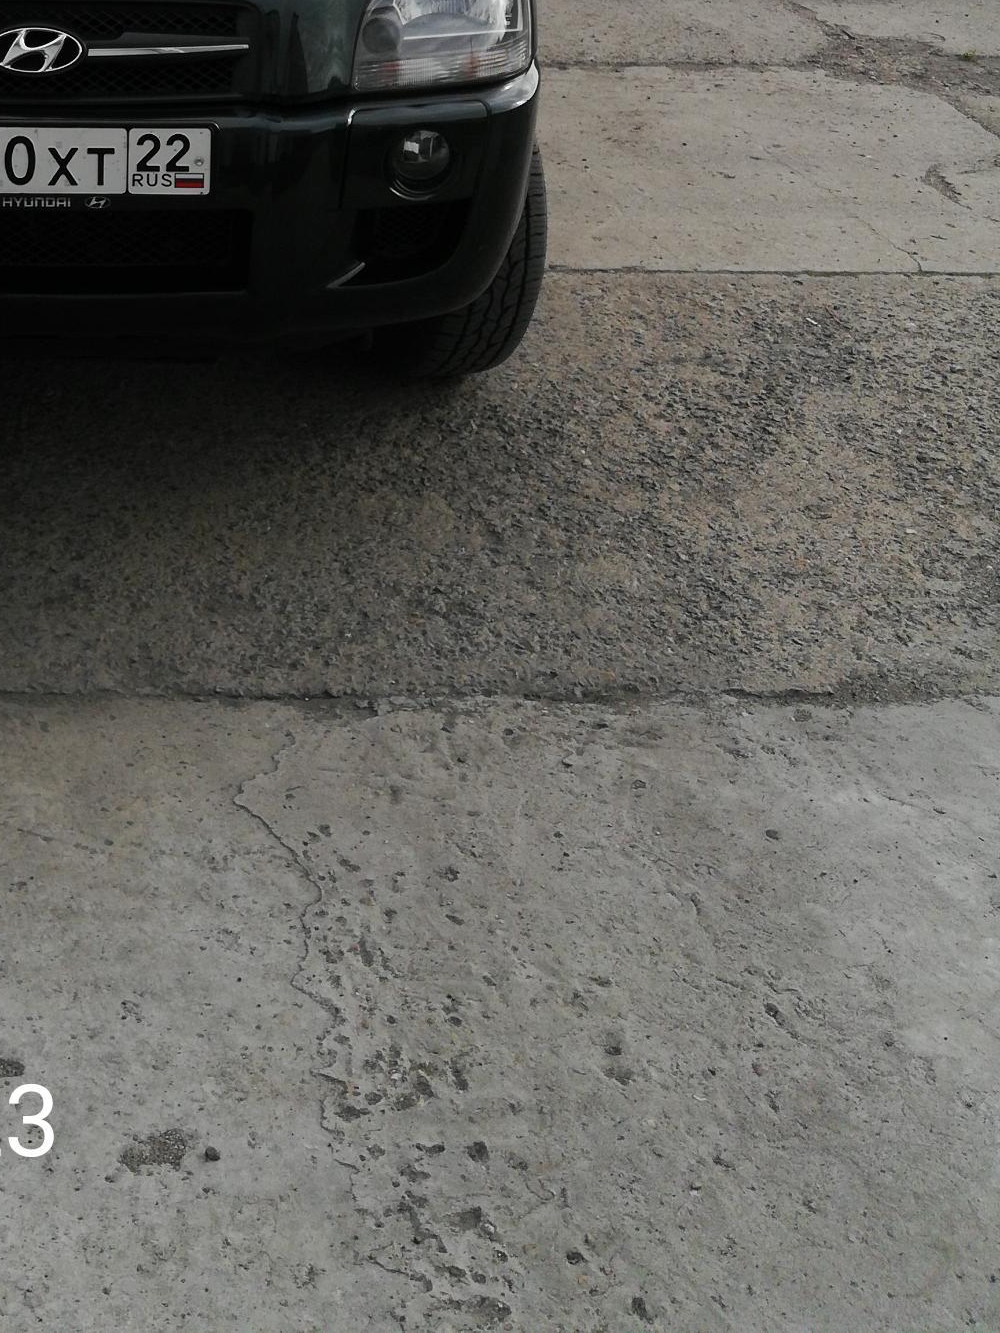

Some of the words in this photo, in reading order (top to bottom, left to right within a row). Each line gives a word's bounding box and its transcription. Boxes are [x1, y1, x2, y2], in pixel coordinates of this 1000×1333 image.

[136, 133, 191, 174] 22
[131, 173, 173, 188] RUS
[2, 197, 71, 208] HYUNDAI
